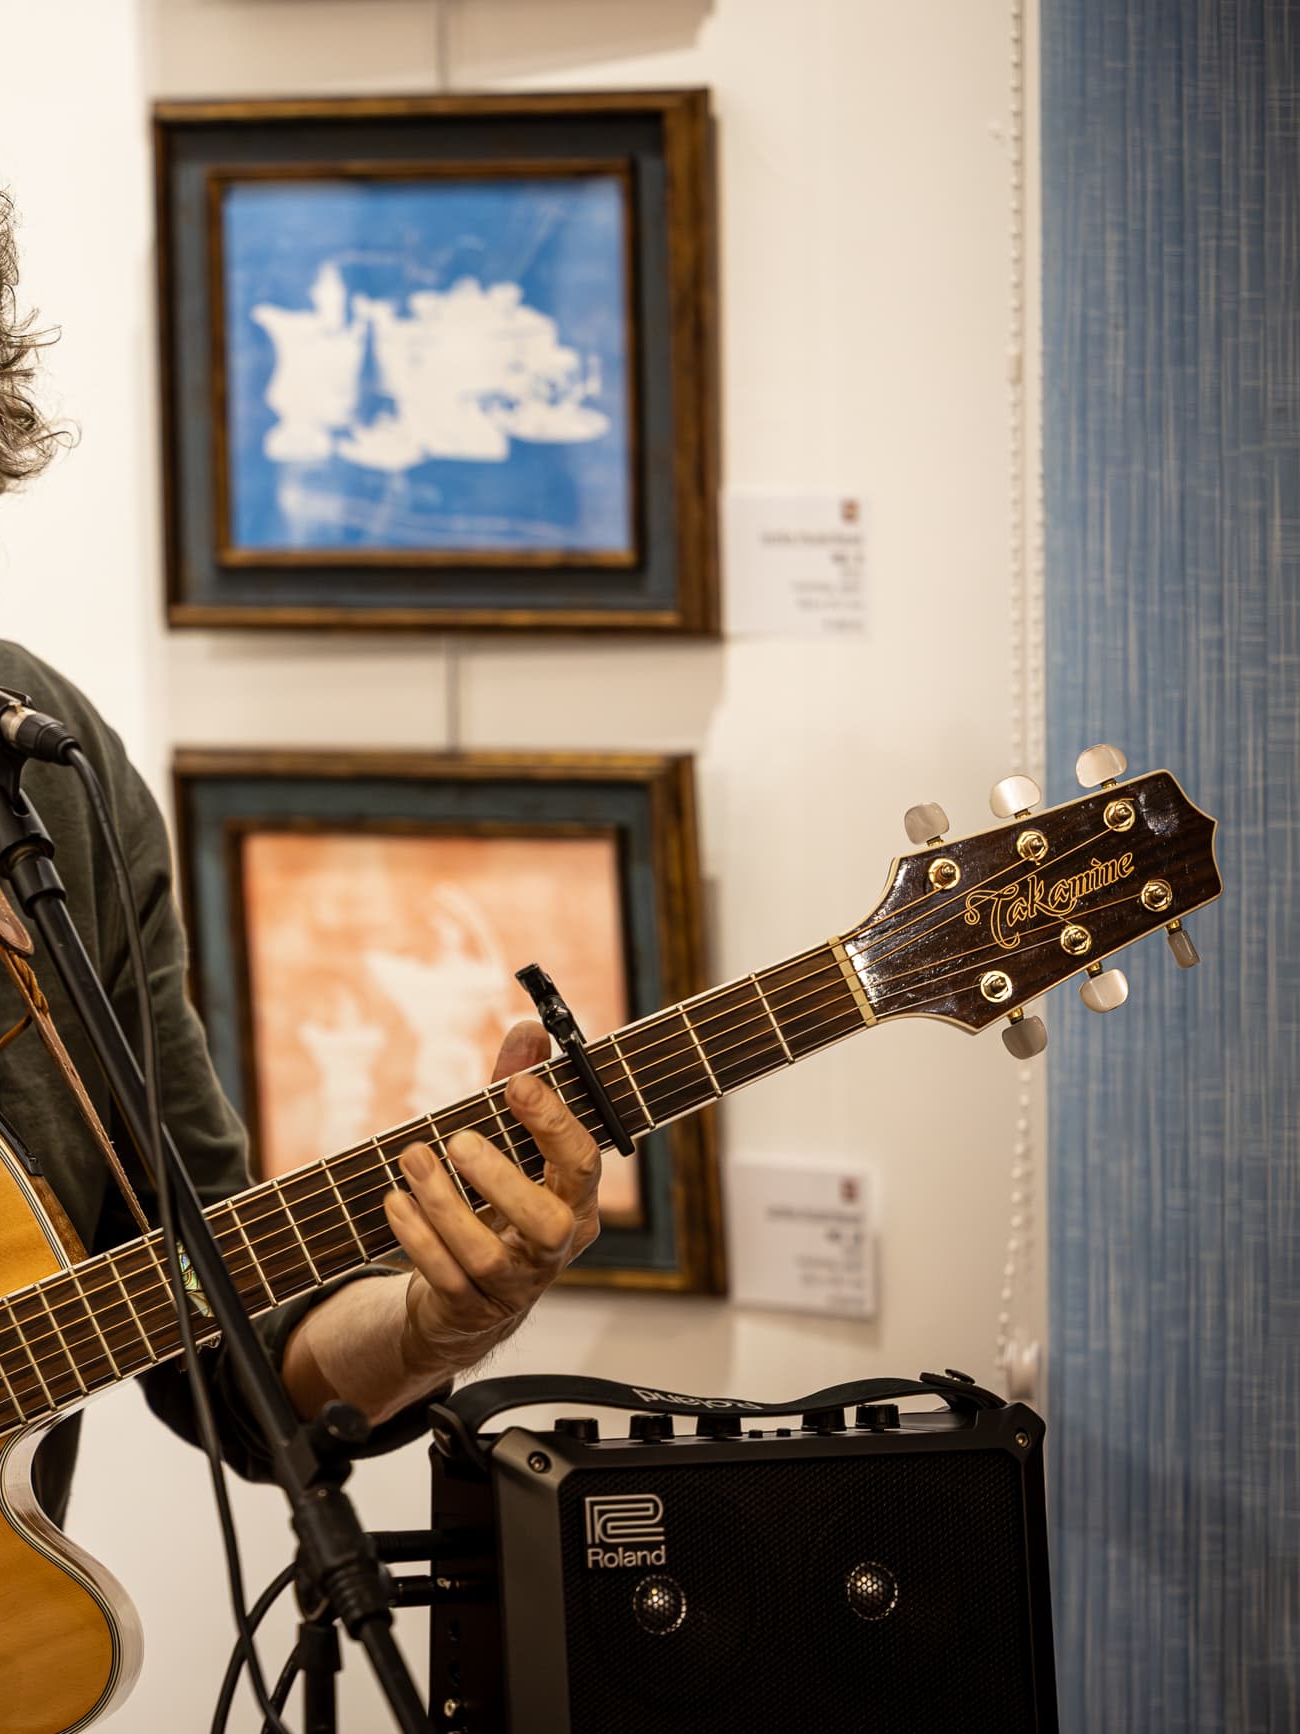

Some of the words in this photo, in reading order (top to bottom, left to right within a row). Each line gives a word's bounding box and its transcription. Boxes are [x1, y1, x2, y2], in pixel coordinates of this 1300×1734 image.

[964, 851, 1135, 949] Takamine
[631, 1388, 765, 1410] Roland
[586, 1545, 666, 1568] Roland
